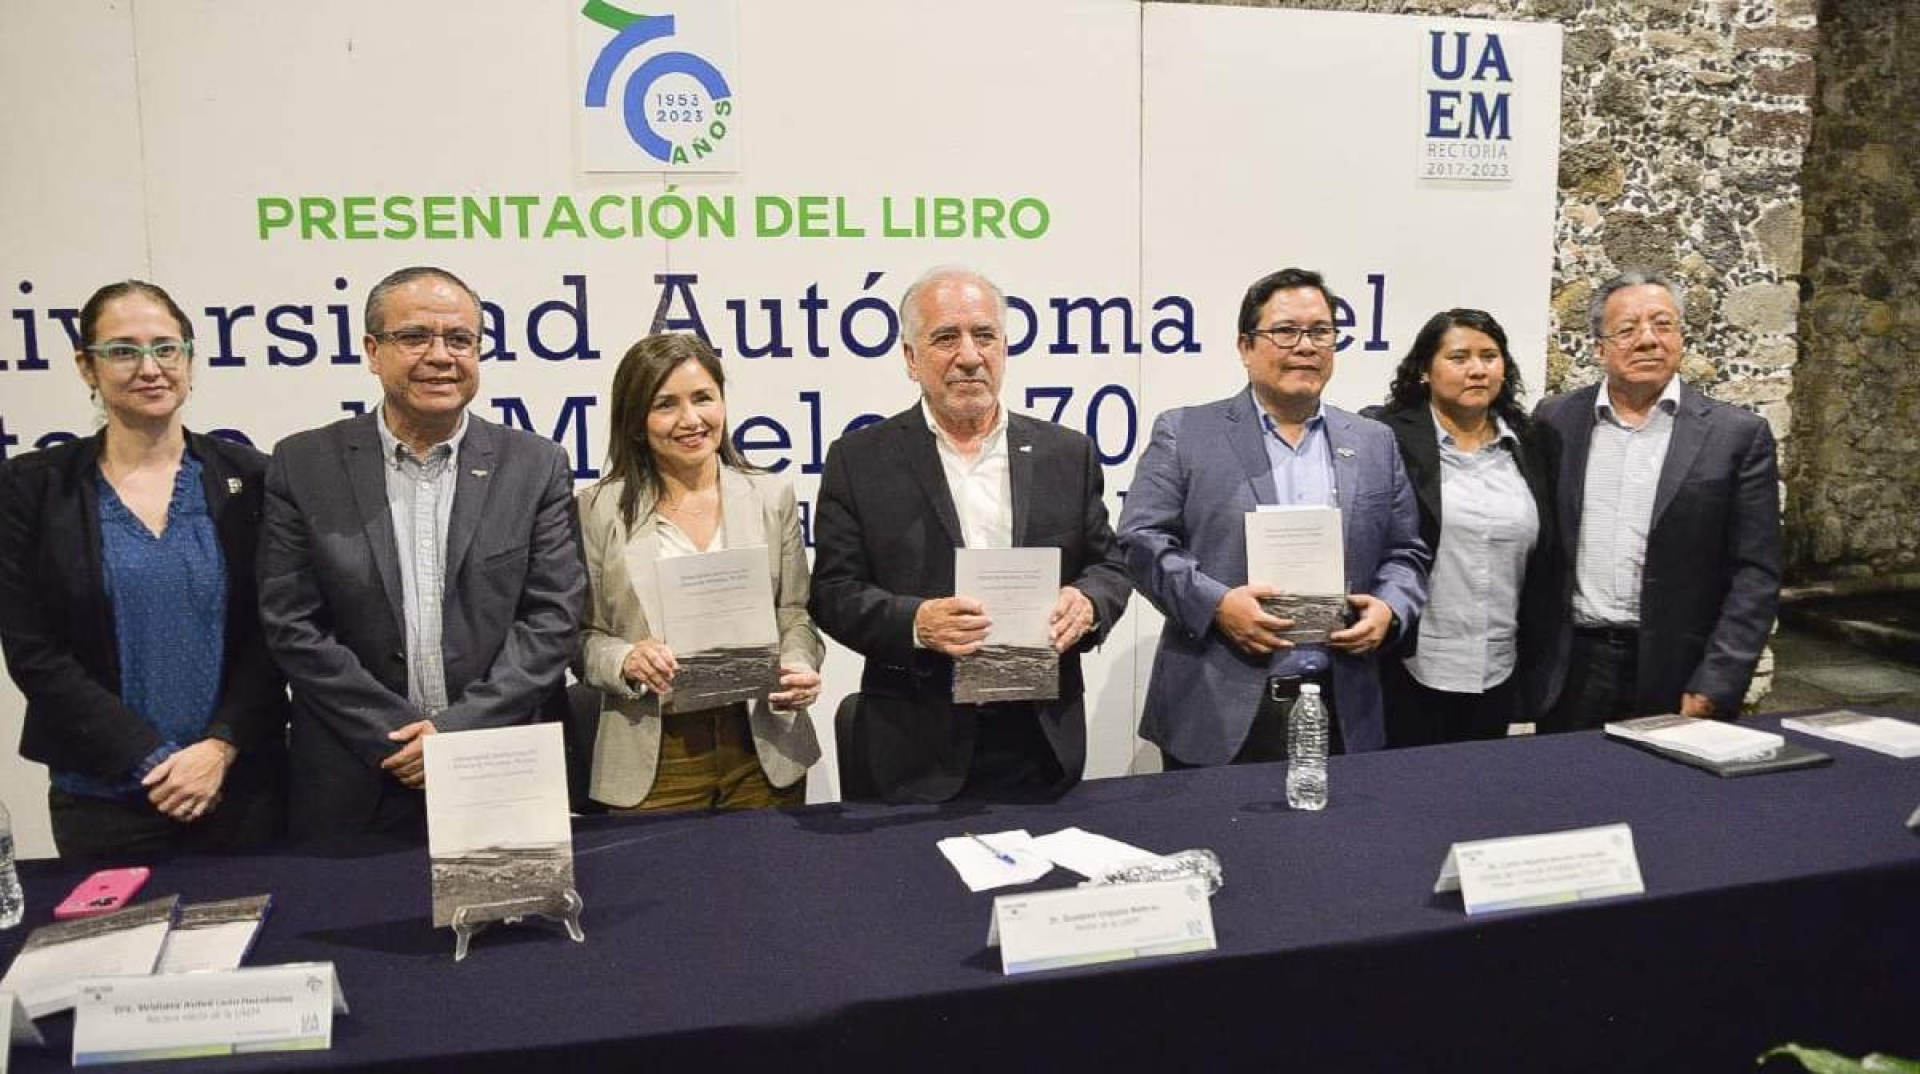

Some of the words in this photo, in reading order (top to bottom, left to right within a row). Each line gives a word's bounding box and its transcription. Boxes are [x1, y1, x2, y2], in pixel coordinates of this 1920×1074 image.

[1429, 30, 1513, 82] UA
[656, 94, 700, 107] 1953
[656, 110, 704, 123] 2023
[1426, 89, 1512, 140] EM
[671, 100, 733, 165] AÑOS
[1426, 163, 1510, 176] 2017-2023
[258, 186, 736, 241] PRESENTACIÓN
[756, 196, 865, 238] DEL
[883, 196, 1051, 240] LIBRO
[648, 271, 1201, 358] Autóoma
